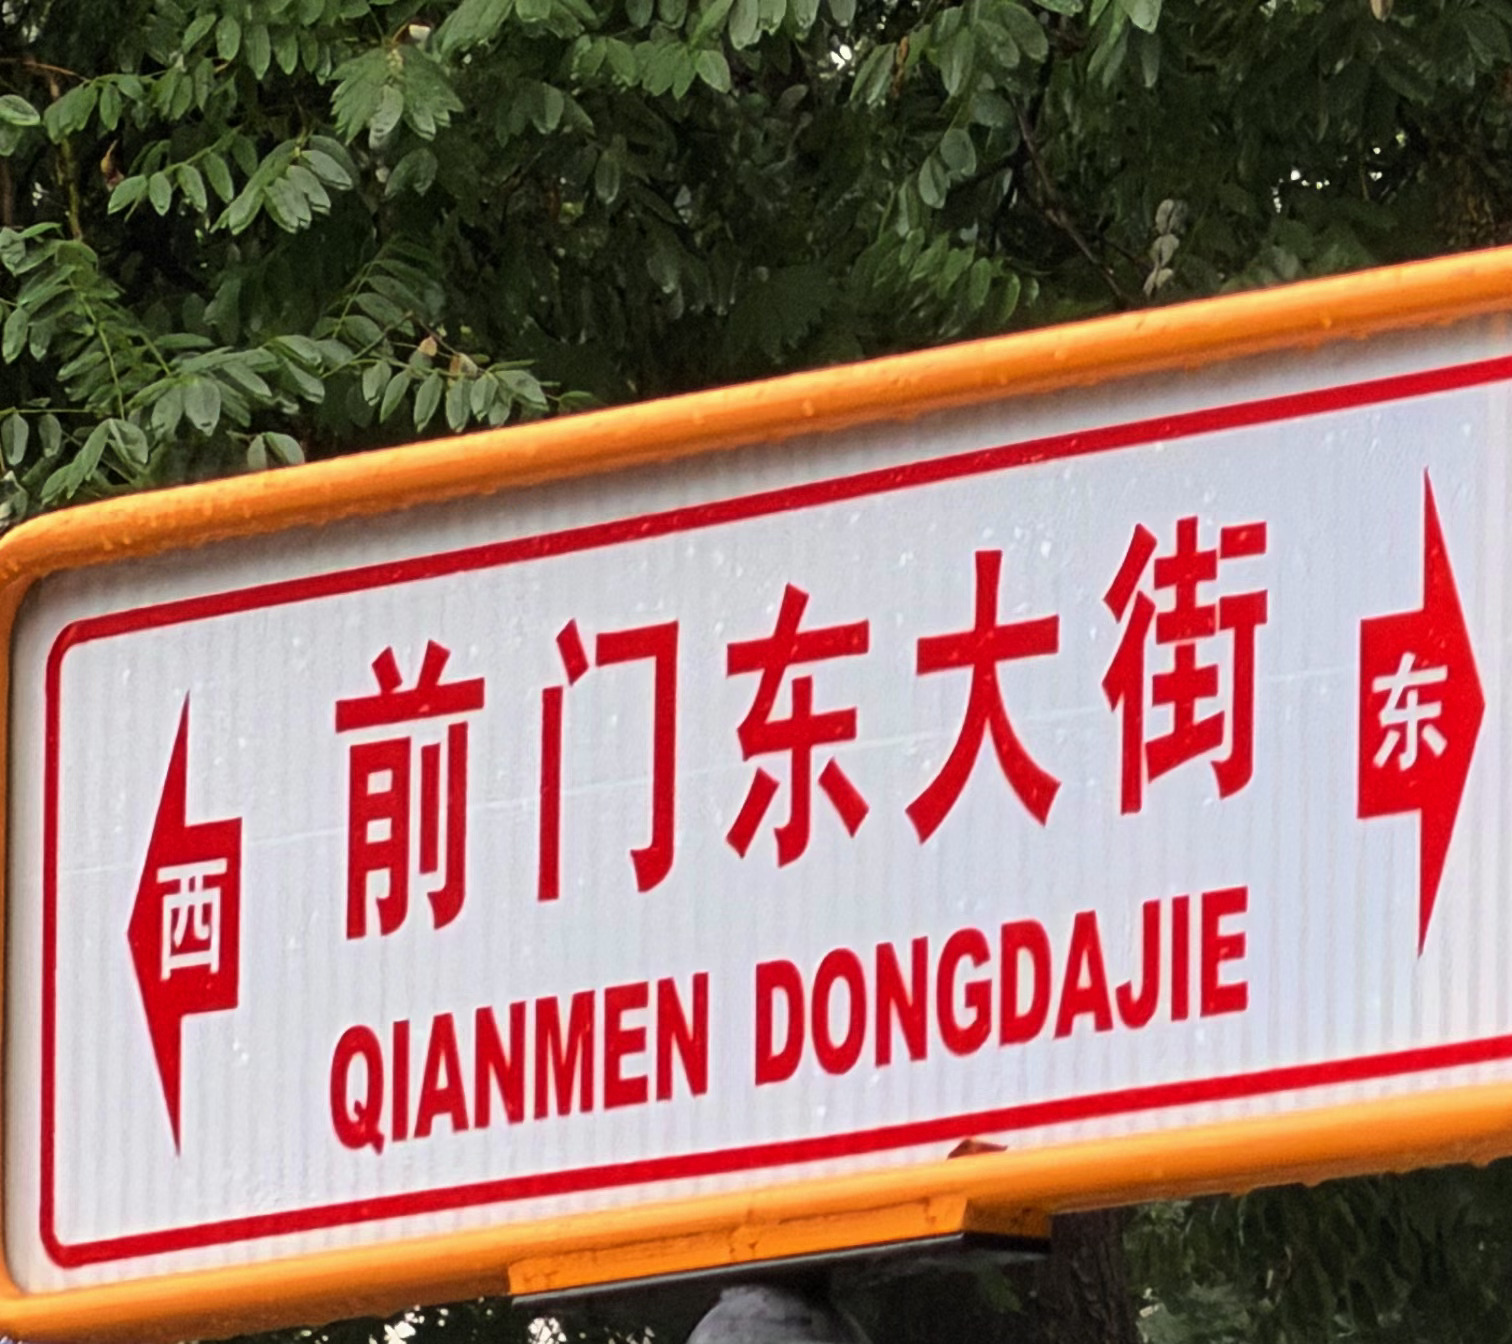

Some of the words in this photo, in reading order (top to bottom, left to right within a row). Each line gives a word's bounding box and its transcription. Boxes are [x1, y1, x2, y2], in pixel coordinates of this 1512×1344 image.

[333, 515, 1269, 941] 前门东大街
[1371, 651, 1449, 772] 东
[155, 856, 228, 981] 西
[329, 971, 710, 1155] QIANMEN
[753, 885, 1249, 1087] DONGDAJIE
